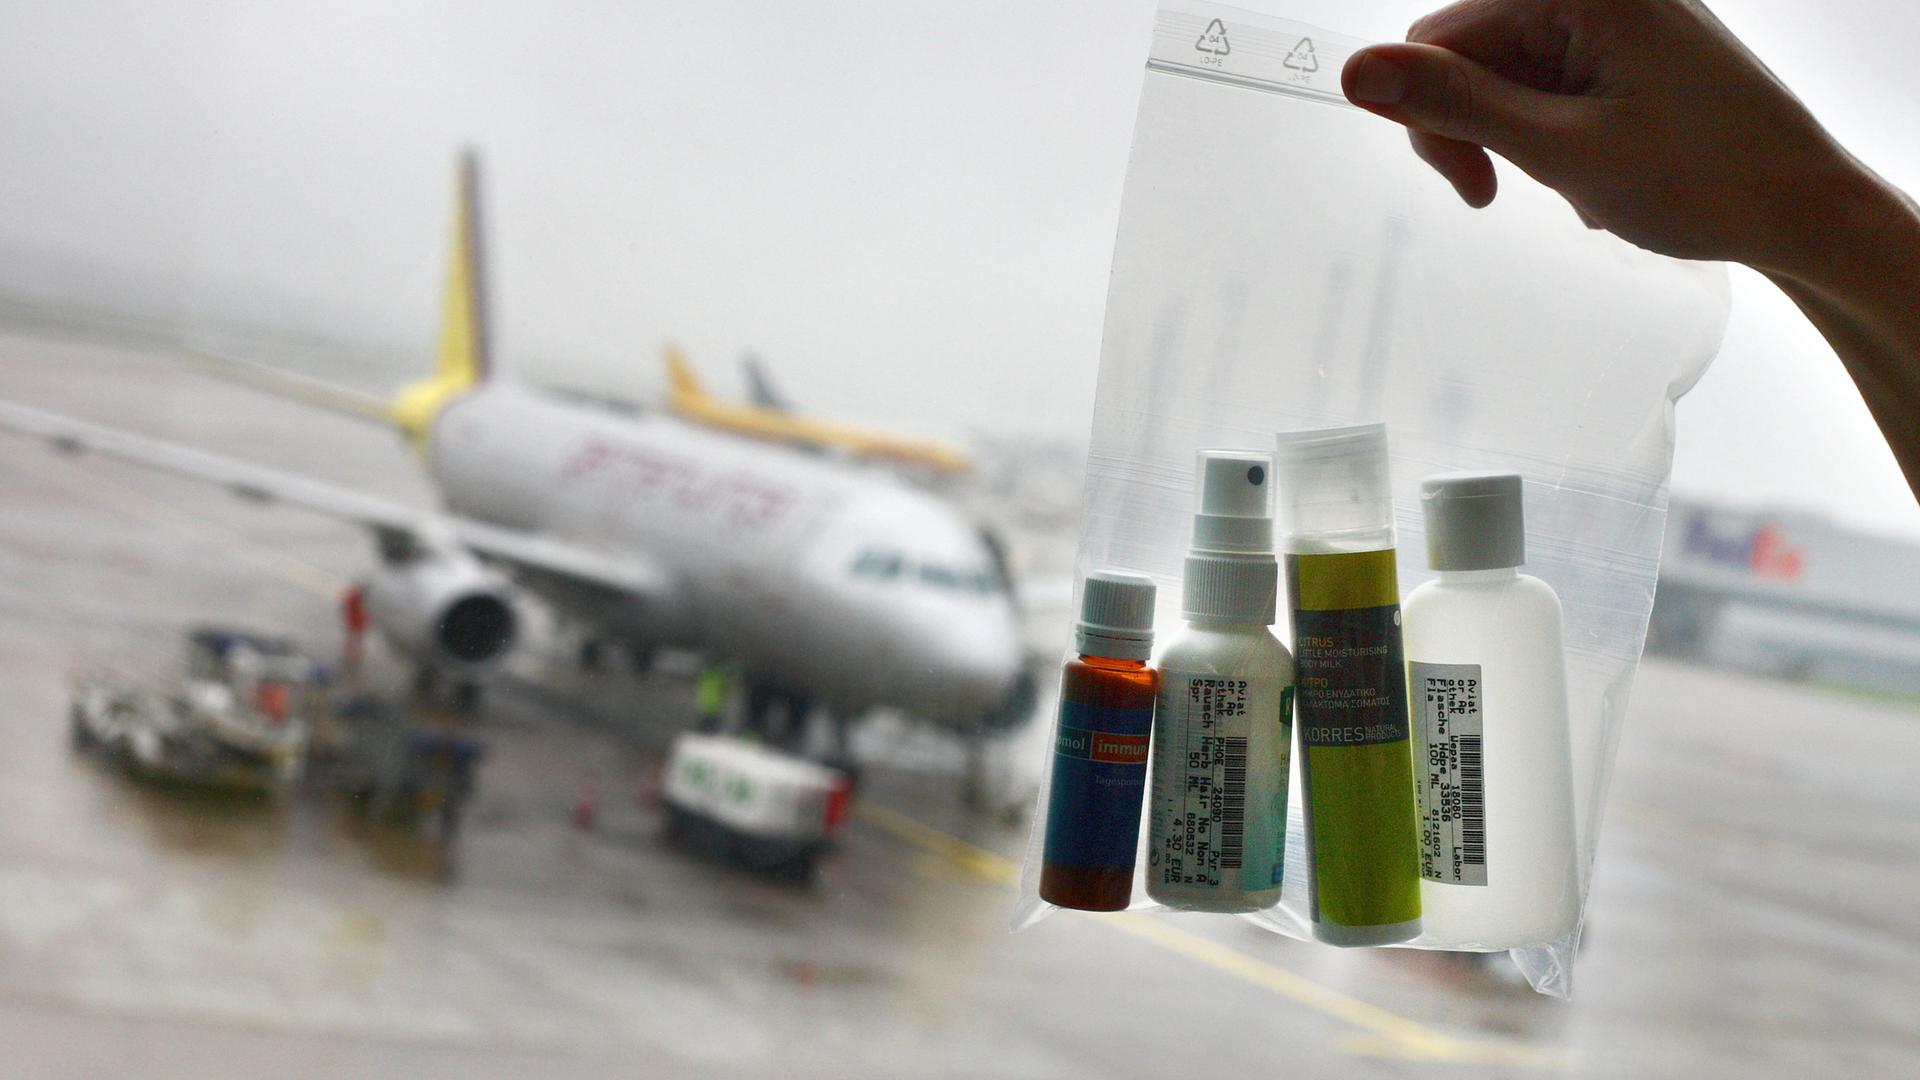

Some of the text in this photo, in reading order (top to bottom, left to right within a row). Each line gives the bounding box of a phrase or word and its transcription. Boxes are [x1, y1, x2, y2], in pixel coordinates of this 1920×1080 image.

[1319, 660, 1341, 668] MILK
[1191, 679, 1203, 701] Spr
[1216, 681, 1226, 716] othek
[1226, 681, 1236, 716] or Ap
[1237, 681, 1247, 716] Aviat
[1427, 678, 1436, 702] Fla
[1448, 679, 1457, 714] othek
[1457, 680, 1467, 714] or Ap
[1467, 679, 1477, 713] Aviat
[1436, 679, 1447, 735] Flasche
[1304, 727, 1364, 742] KORRES
[1189, 752, 1200, 769] 50
[1200, 736, 1212, 769] Herb
[1214, 737, 1225, 766] PHOE
[1429, 744, 1439, 766] 100
[1439, 743, 1449, 775] Hdpe
[1188, 776, 1200, 792] ML
[1431, 773, 1440, 788] ML
[1451, 785, 1461, 819] 18080
[1198, 817, 1209, 833] No
[1423, 816, 1432, 846] 1.00
[1431, 809, 1440, 857] 8121602
[1170, 818, 1183, 883] 4.30 EUR
[1196, 842, 1208, 866] Non
[1209, 851, 1219, 870] Pyr
[1424, 853, 1433, 877] EUR
[1453, 847, 1462, 881] Labor
[1184, 875, 1193, 884] N
